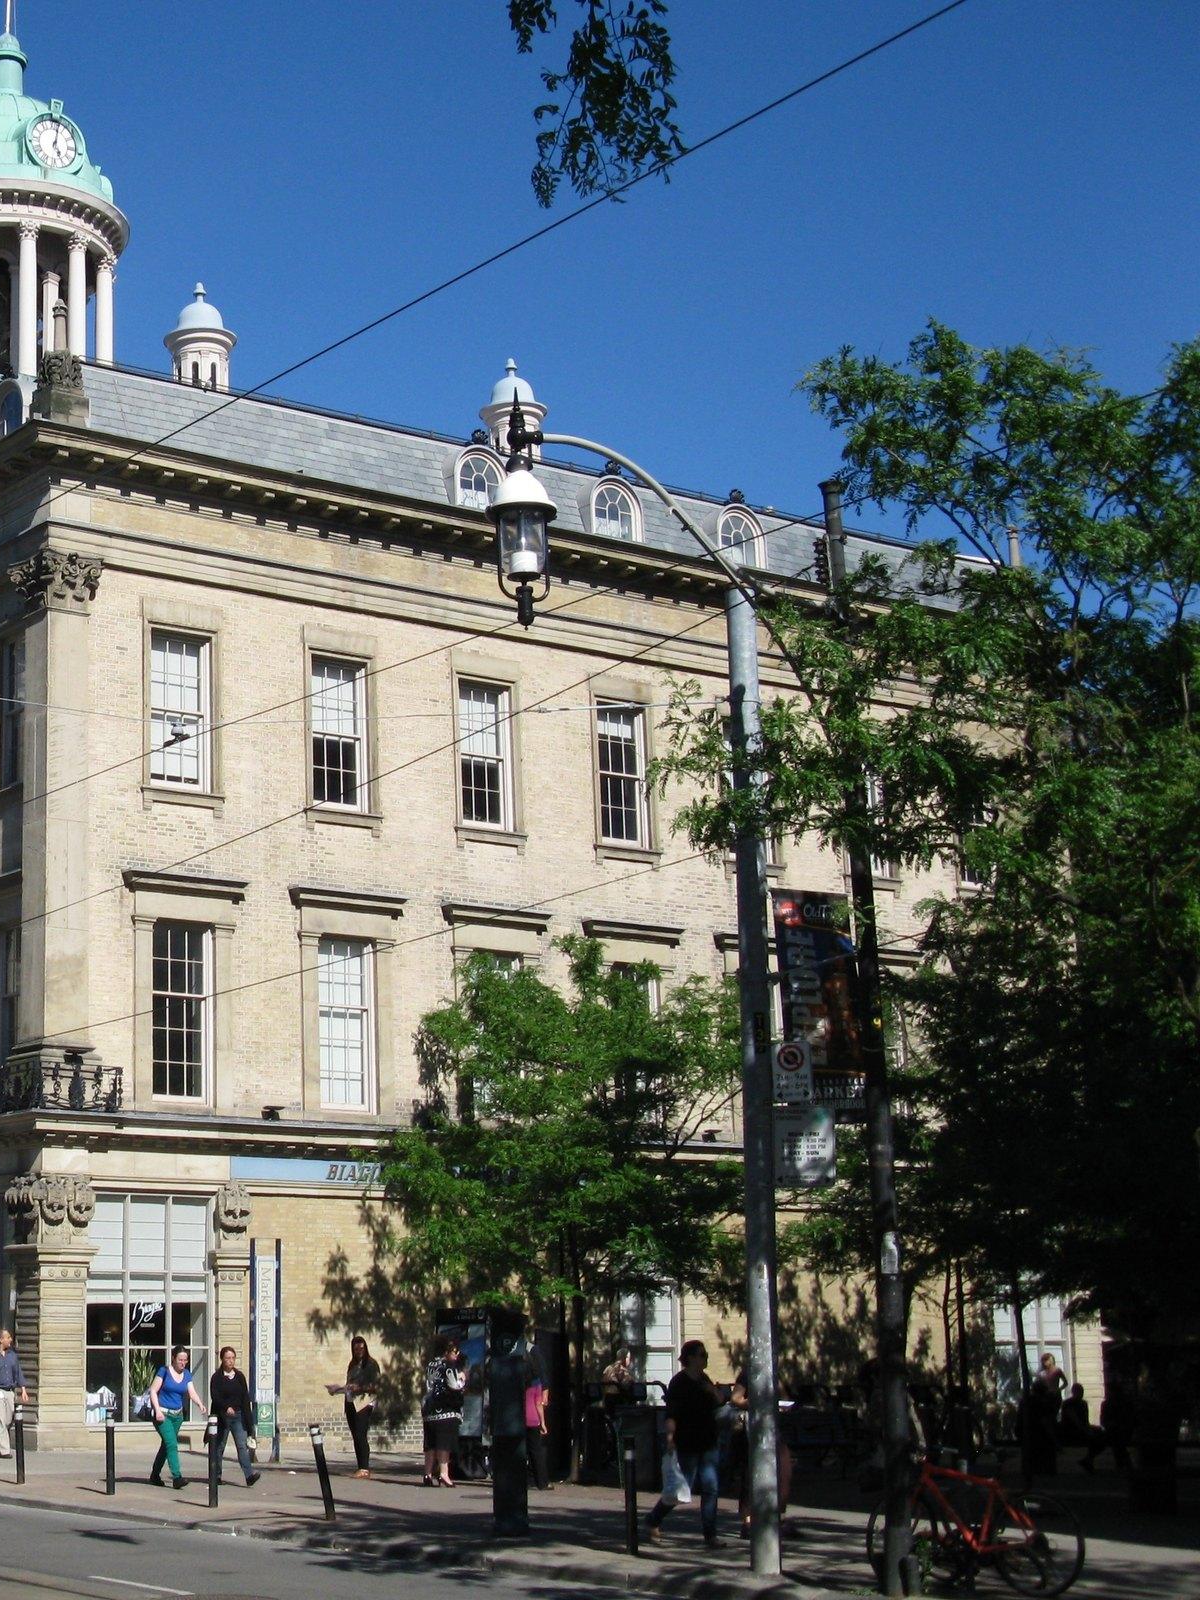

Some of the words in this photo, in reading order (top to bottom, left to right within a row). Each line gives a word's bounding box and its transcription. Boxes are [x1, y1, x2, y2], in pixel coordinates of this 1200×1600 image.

[813, 1086, 864, 1098] ARKET
[260, 1267, 272, 1314] Market
[260, 1318, 272, 1349] Lane
[260, 1353, 272, 1382] Park
